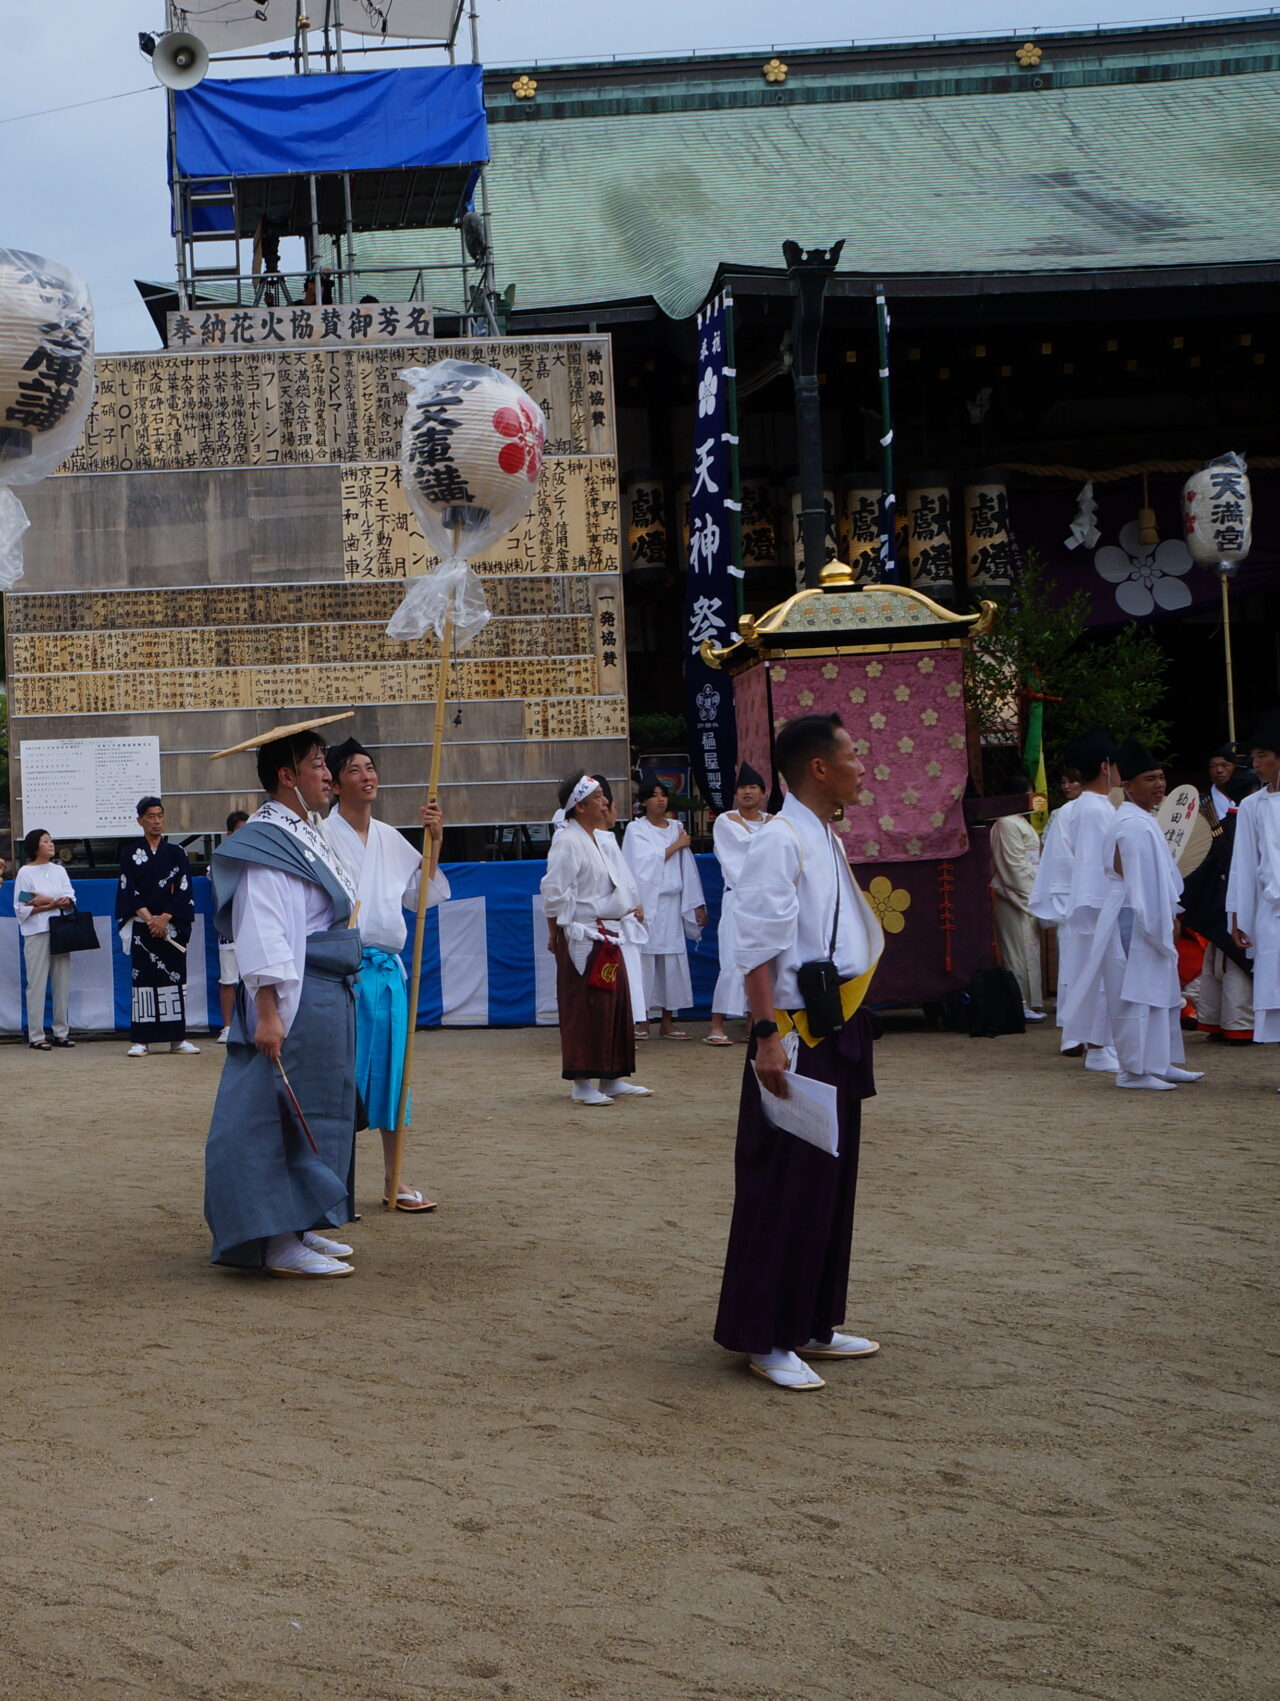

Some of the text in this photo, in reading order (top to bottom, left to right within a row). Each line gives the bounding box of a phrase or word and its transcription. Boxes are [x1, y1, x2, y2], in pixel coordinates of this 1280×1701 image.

[172, 308, 432, 346] 奉納花火協賛御芳名
[100, 360, 119, 473] 大阪硝子(株)
[586, 349, 607, 428] 特別協賛
[689, 437, 727, 656] 天神祭
[1209, 471, 1247, 554] 天満宮
[598, 594, 618, 668] 一発協賛
